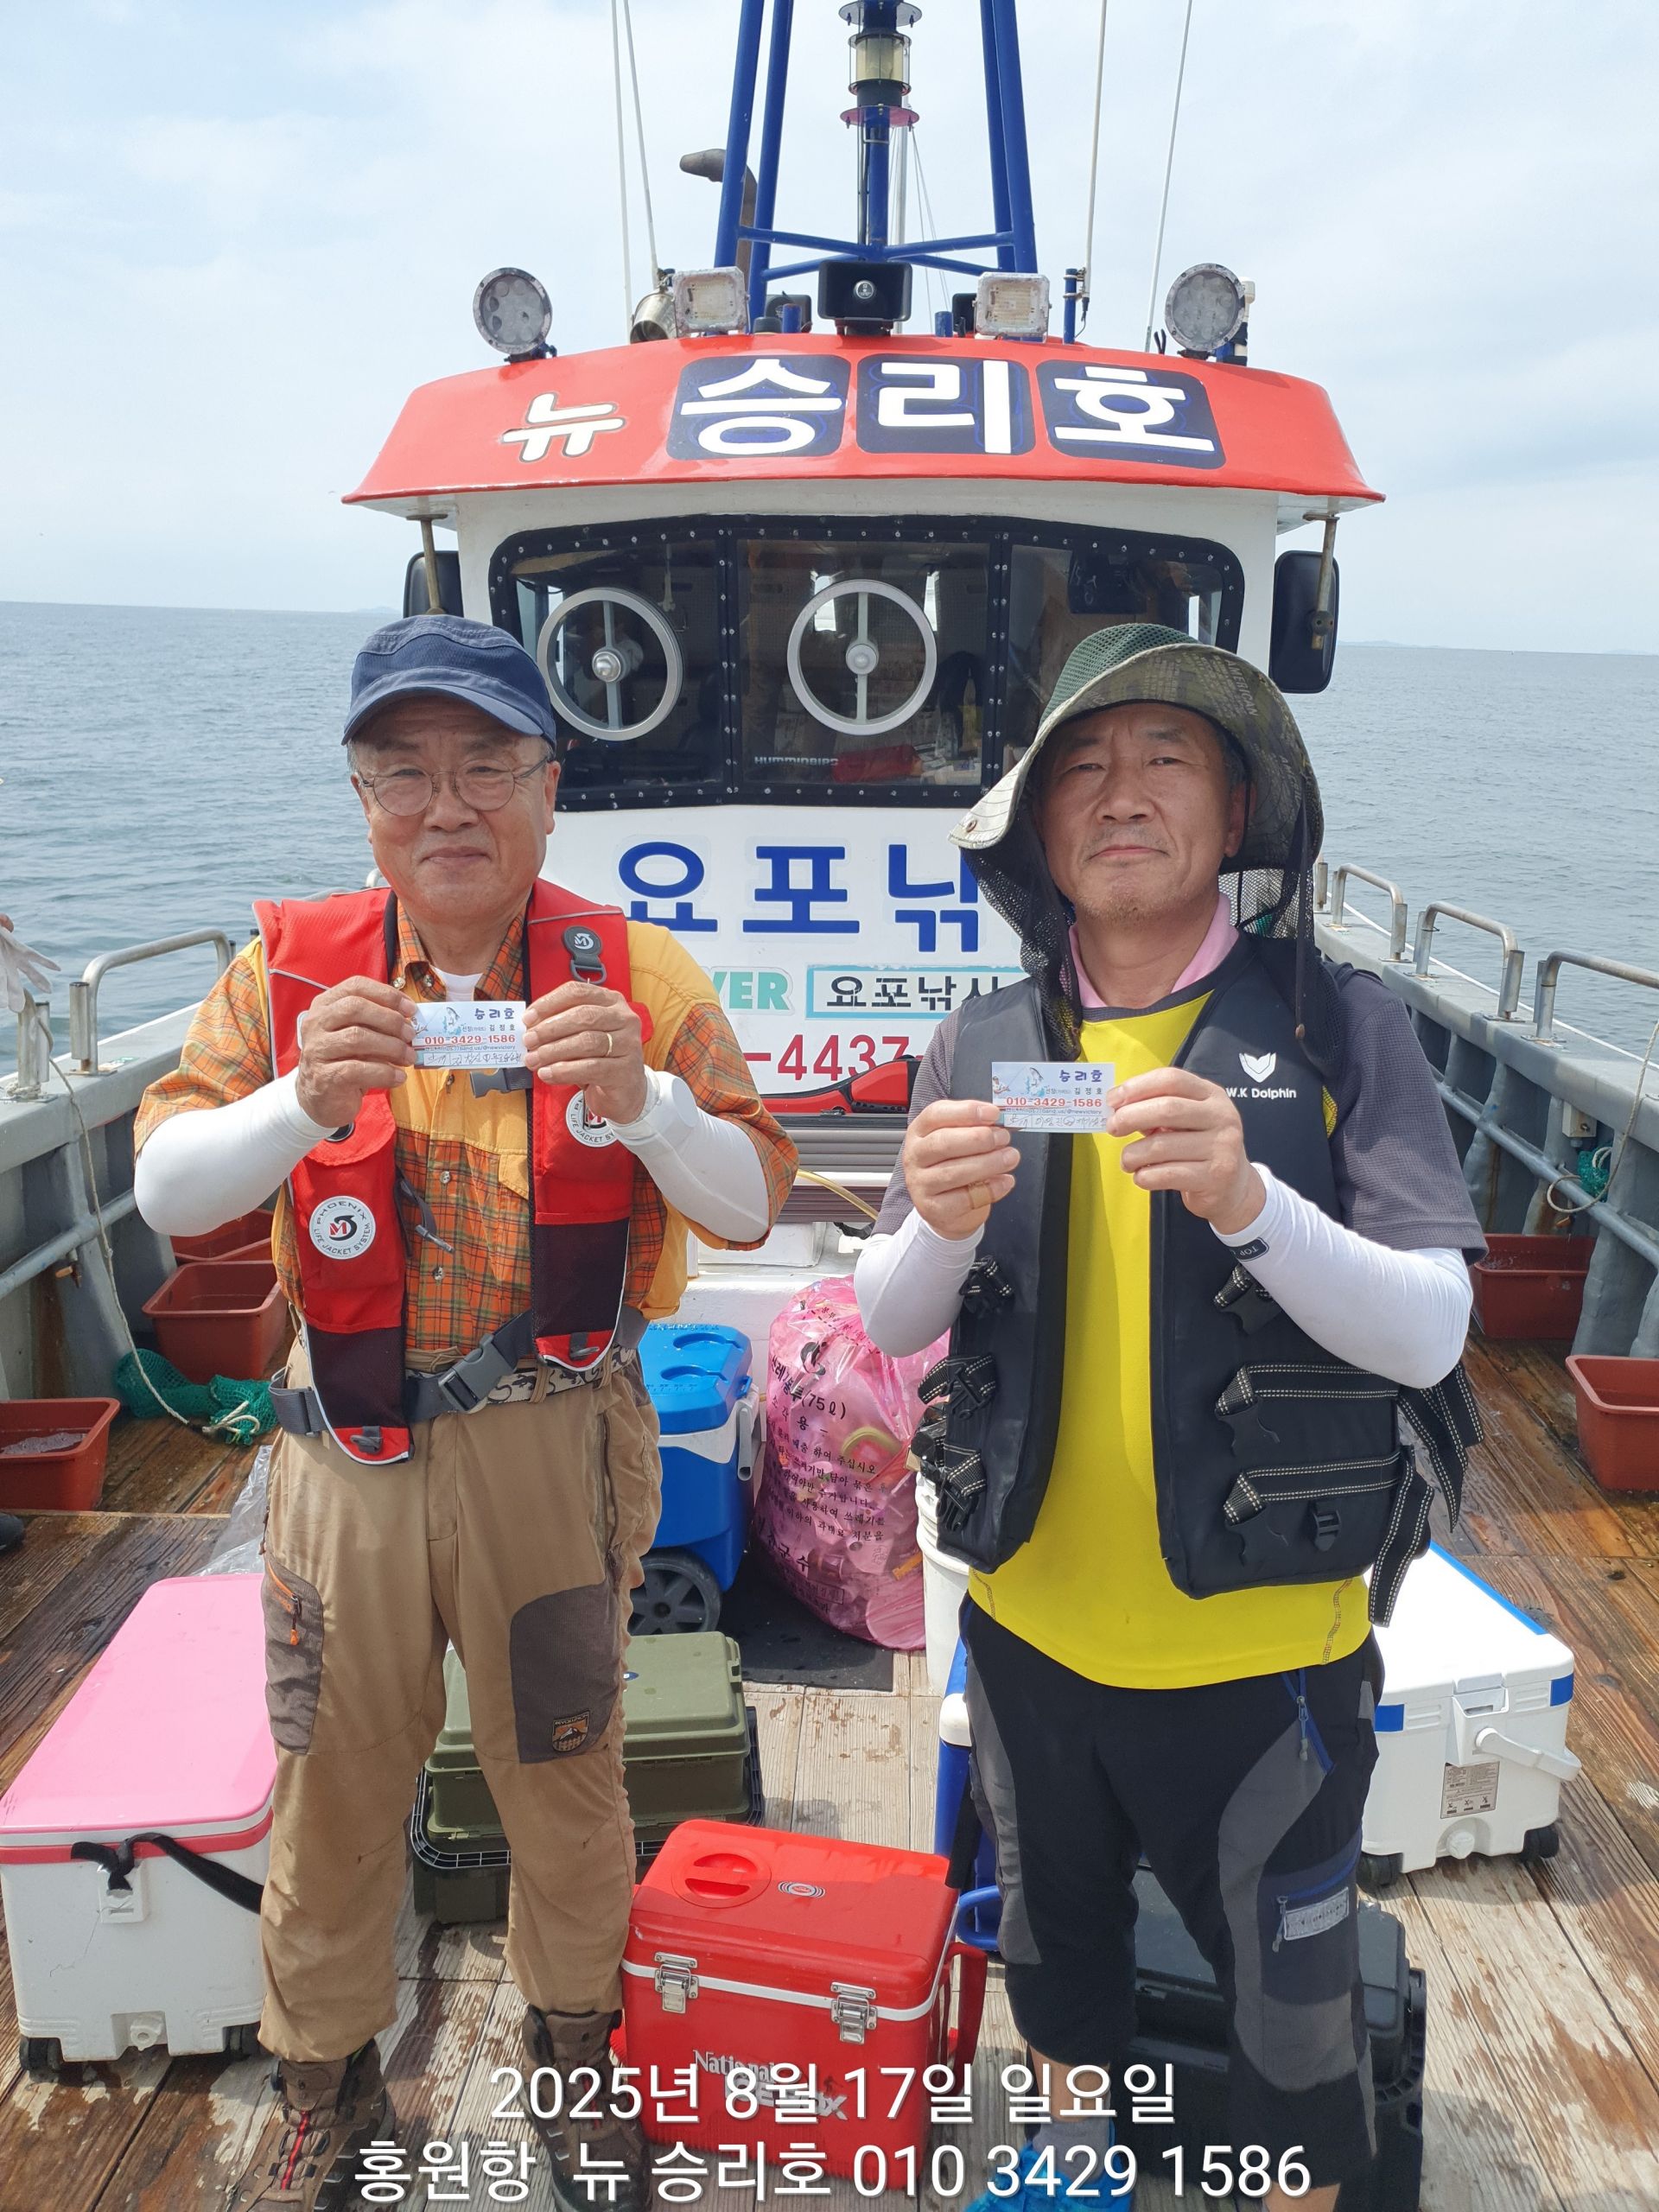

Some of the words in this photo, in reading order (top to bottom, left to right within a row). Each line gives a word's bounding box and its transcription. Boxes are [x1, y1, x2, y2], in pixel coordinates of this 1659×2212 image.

[501, 392, 626, 464] 뉴
[679, 358, 1216, 455] 승리호
[1006, 1096, 1103, 1108] 010-3429-1586
[1251, 1087, 1297, 1100] Dolphin
[576, 1130, 602, 1142] JACKET
[316, 1200, 367, 1224] PHOENIX
[314, 1229, 325, 1243] LIFE
[322, 1244, 352, 1255] JACKET
[353, 1223, 371, 1251] SYSTEM
[837, 1454, 877, 1474] 주십시오
